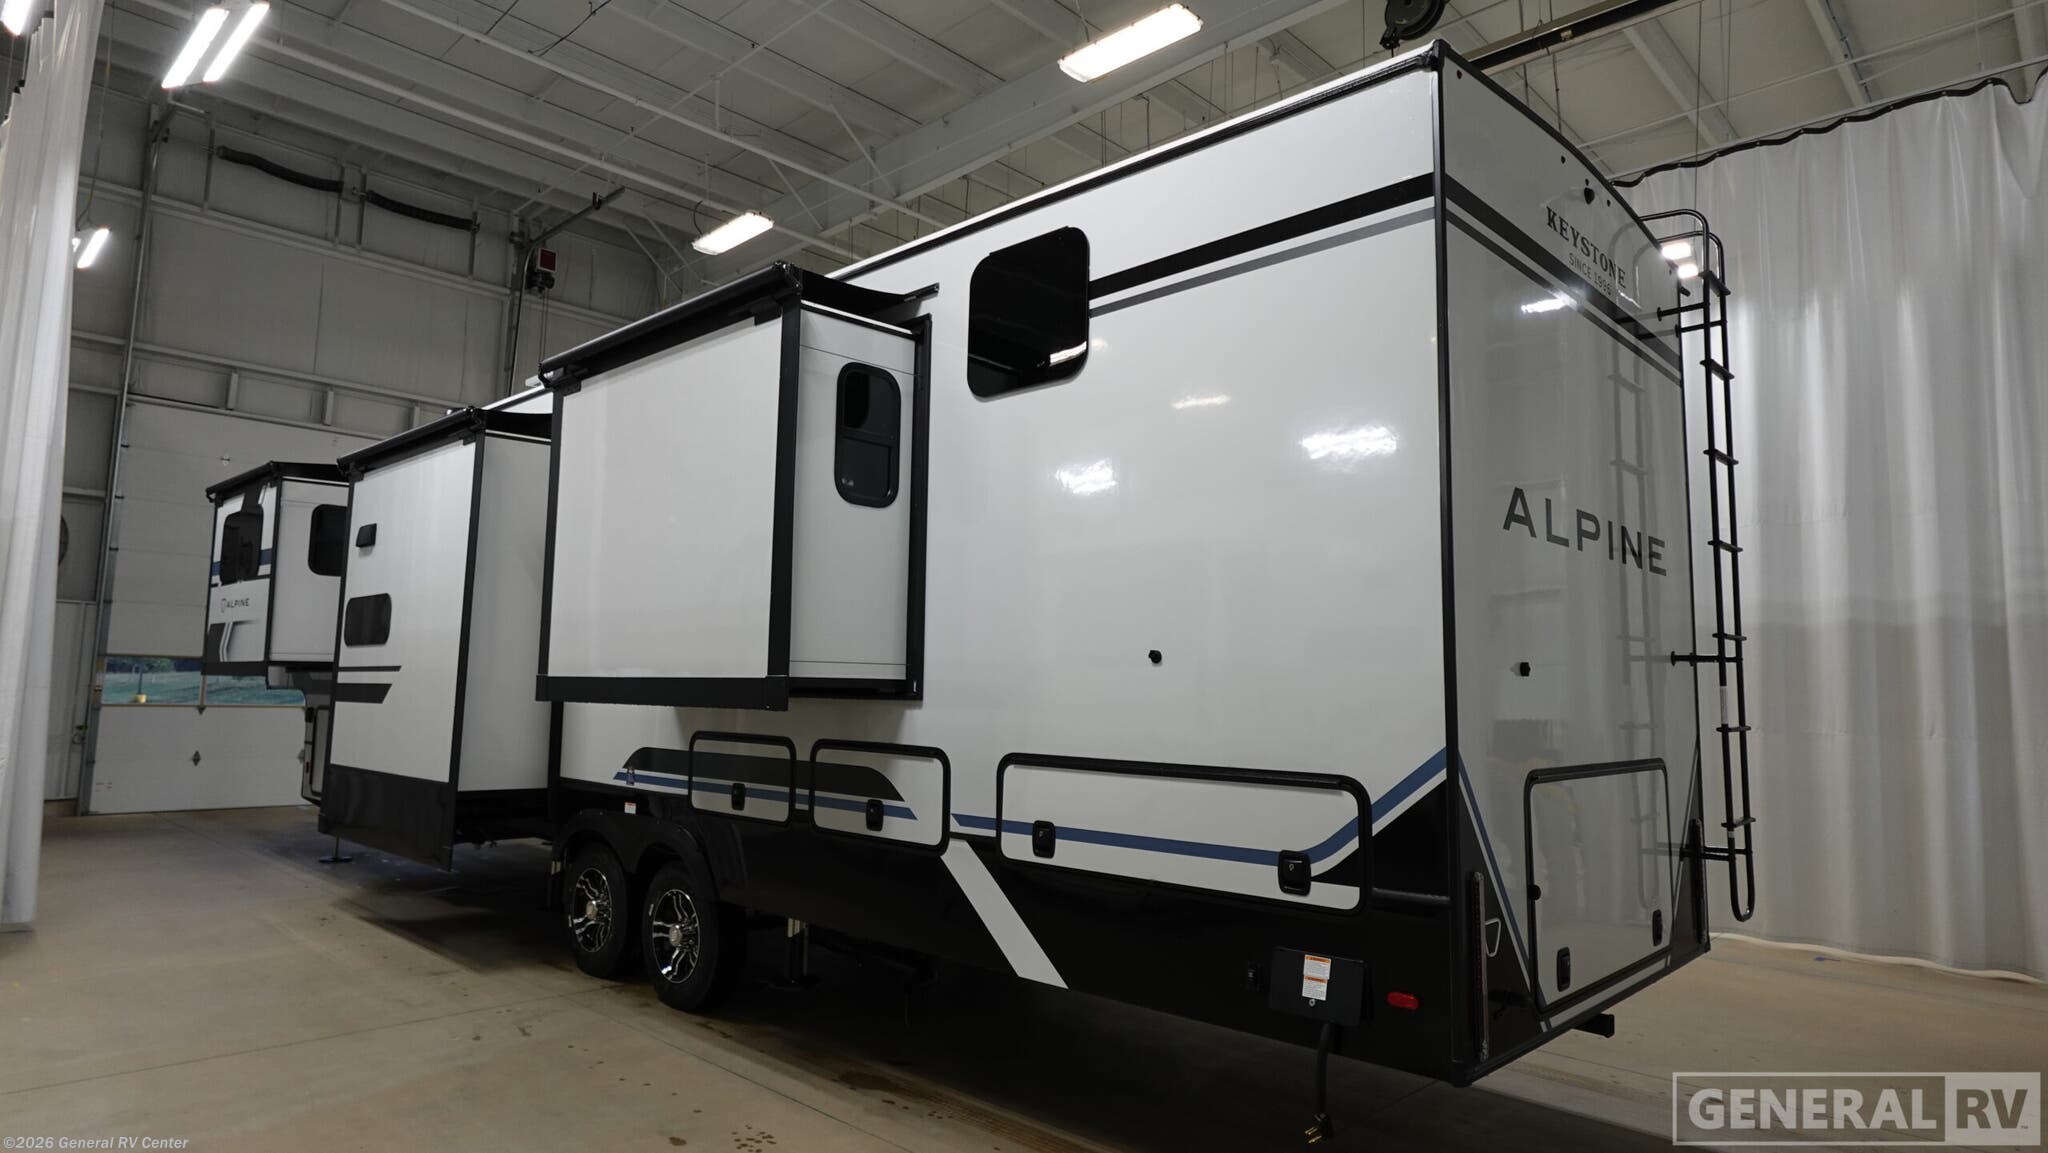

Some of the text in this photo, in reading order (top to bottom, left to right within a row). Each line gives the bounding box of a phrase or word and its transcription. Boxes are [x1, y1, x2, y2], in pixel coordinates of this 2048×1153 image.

[1546, 205, 1627, 289] KEYSTONE
[1568, 252, 1592, 280] SINCE
[1502, 486, 1667, 577] ALPINE
[226, 598, 250, 608] ALPINE
